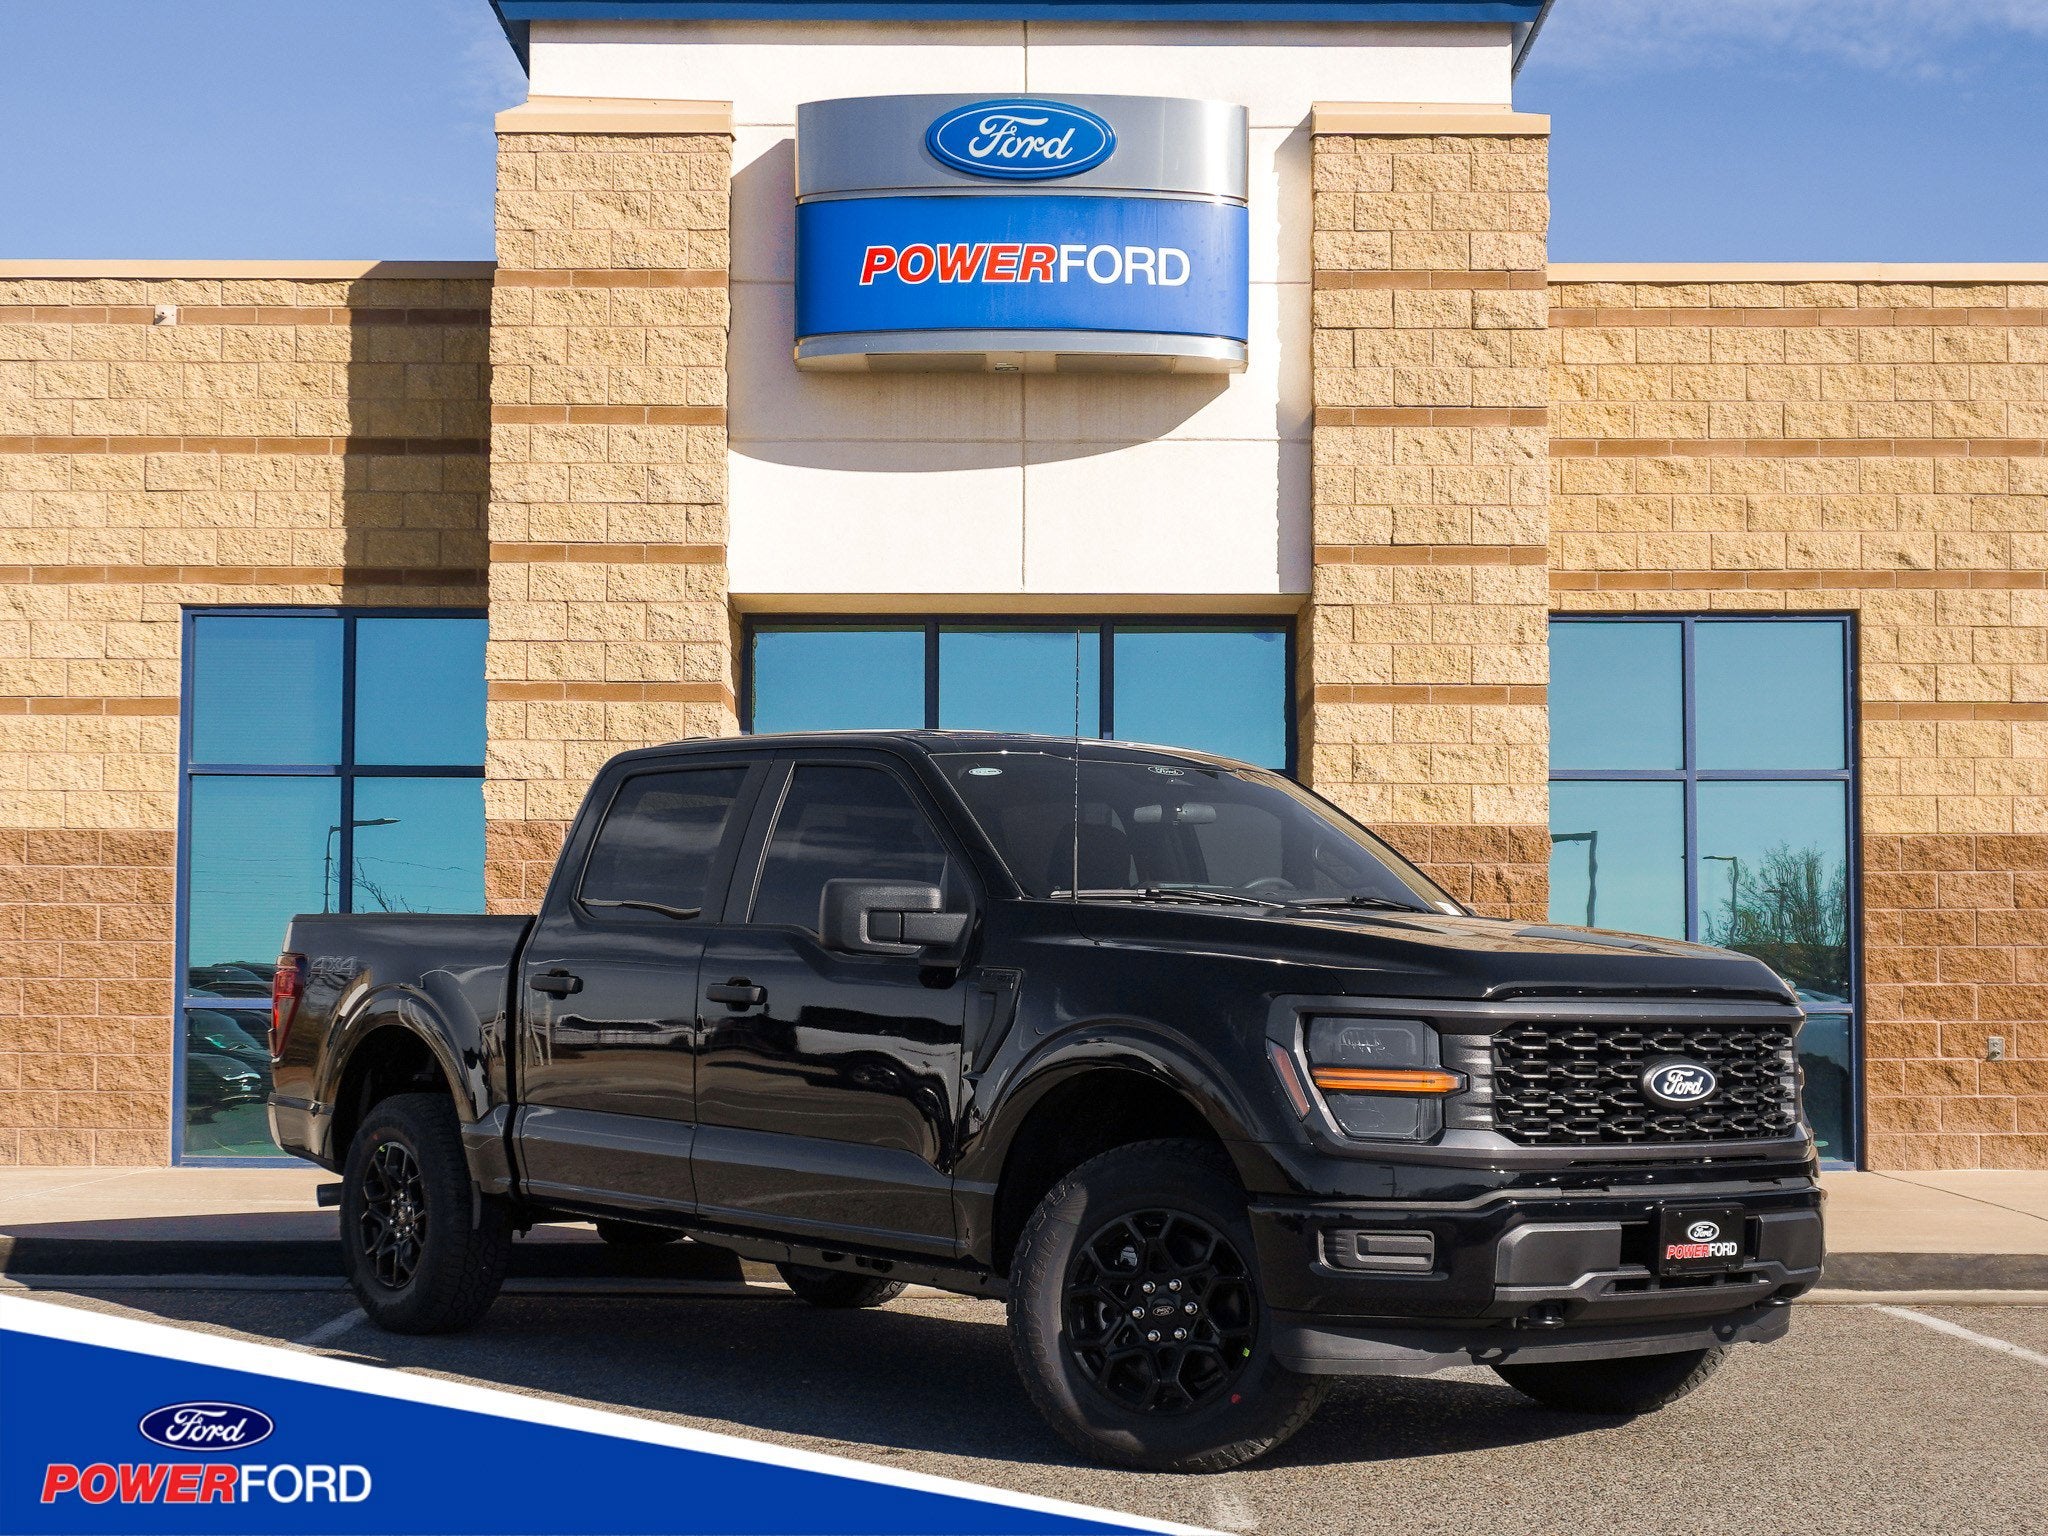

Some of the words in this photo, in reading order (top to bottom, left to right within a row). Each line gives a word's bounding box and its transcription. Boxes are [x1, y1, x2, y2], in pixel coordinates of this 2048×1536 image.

[967, 114, 1076, 160] Ford
[858, 242, 1192, 287] POWERFORD
[1663, 1069, 1704, 1096] Ford
[1665, 1242, 1738, 1260] POWERFORD
